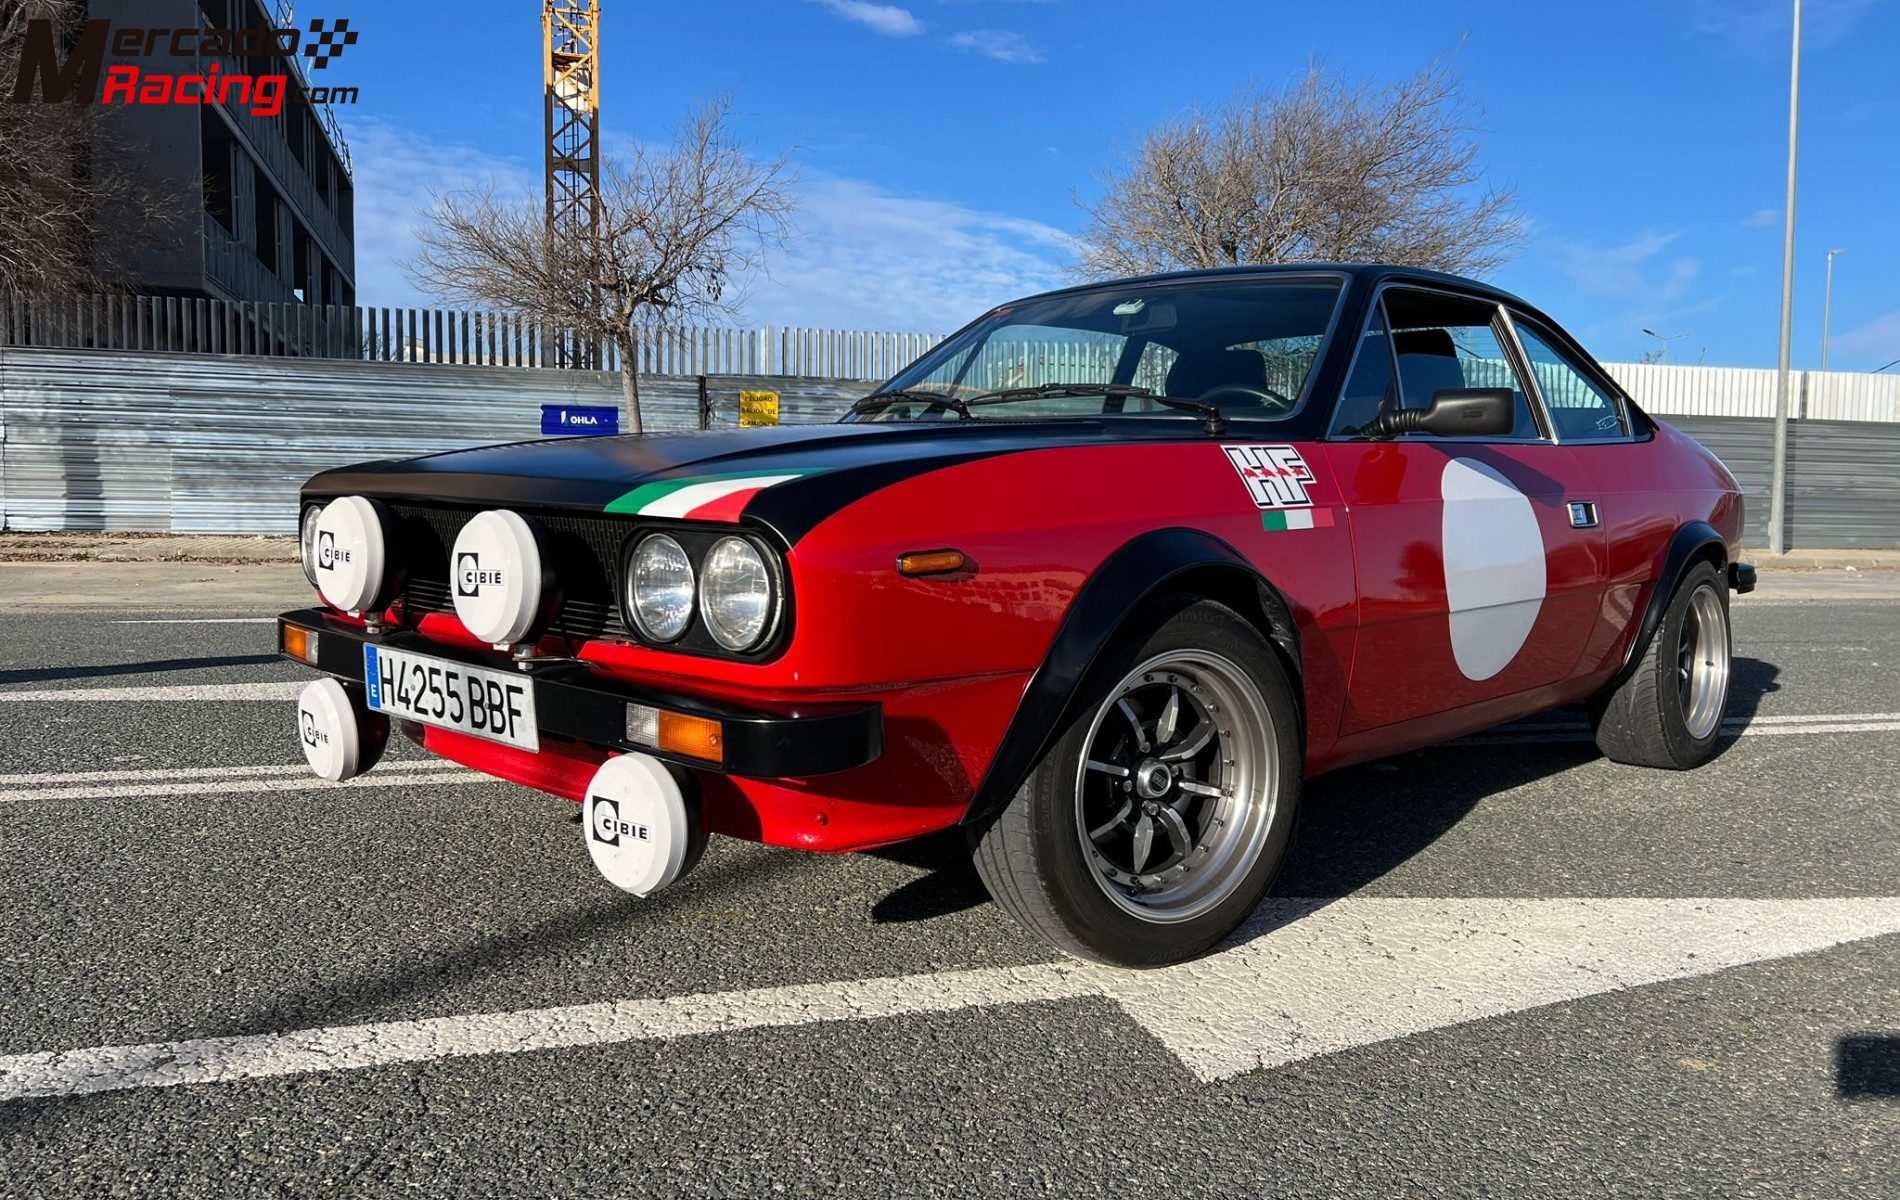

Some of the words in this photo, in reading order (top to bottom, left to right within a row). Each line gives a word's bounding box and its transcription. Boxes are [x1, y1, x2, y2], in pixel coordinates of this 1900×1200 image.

[570, 416, 598, 424] OHLA
[325, 548, 351, 562] CIBIE
[466, 571, 502, 584] CIBIE
[371, 684, 377, 698] E
[308, 726, 329, 744] CIBIE
[602, 818, 648, 840] CIBIE
